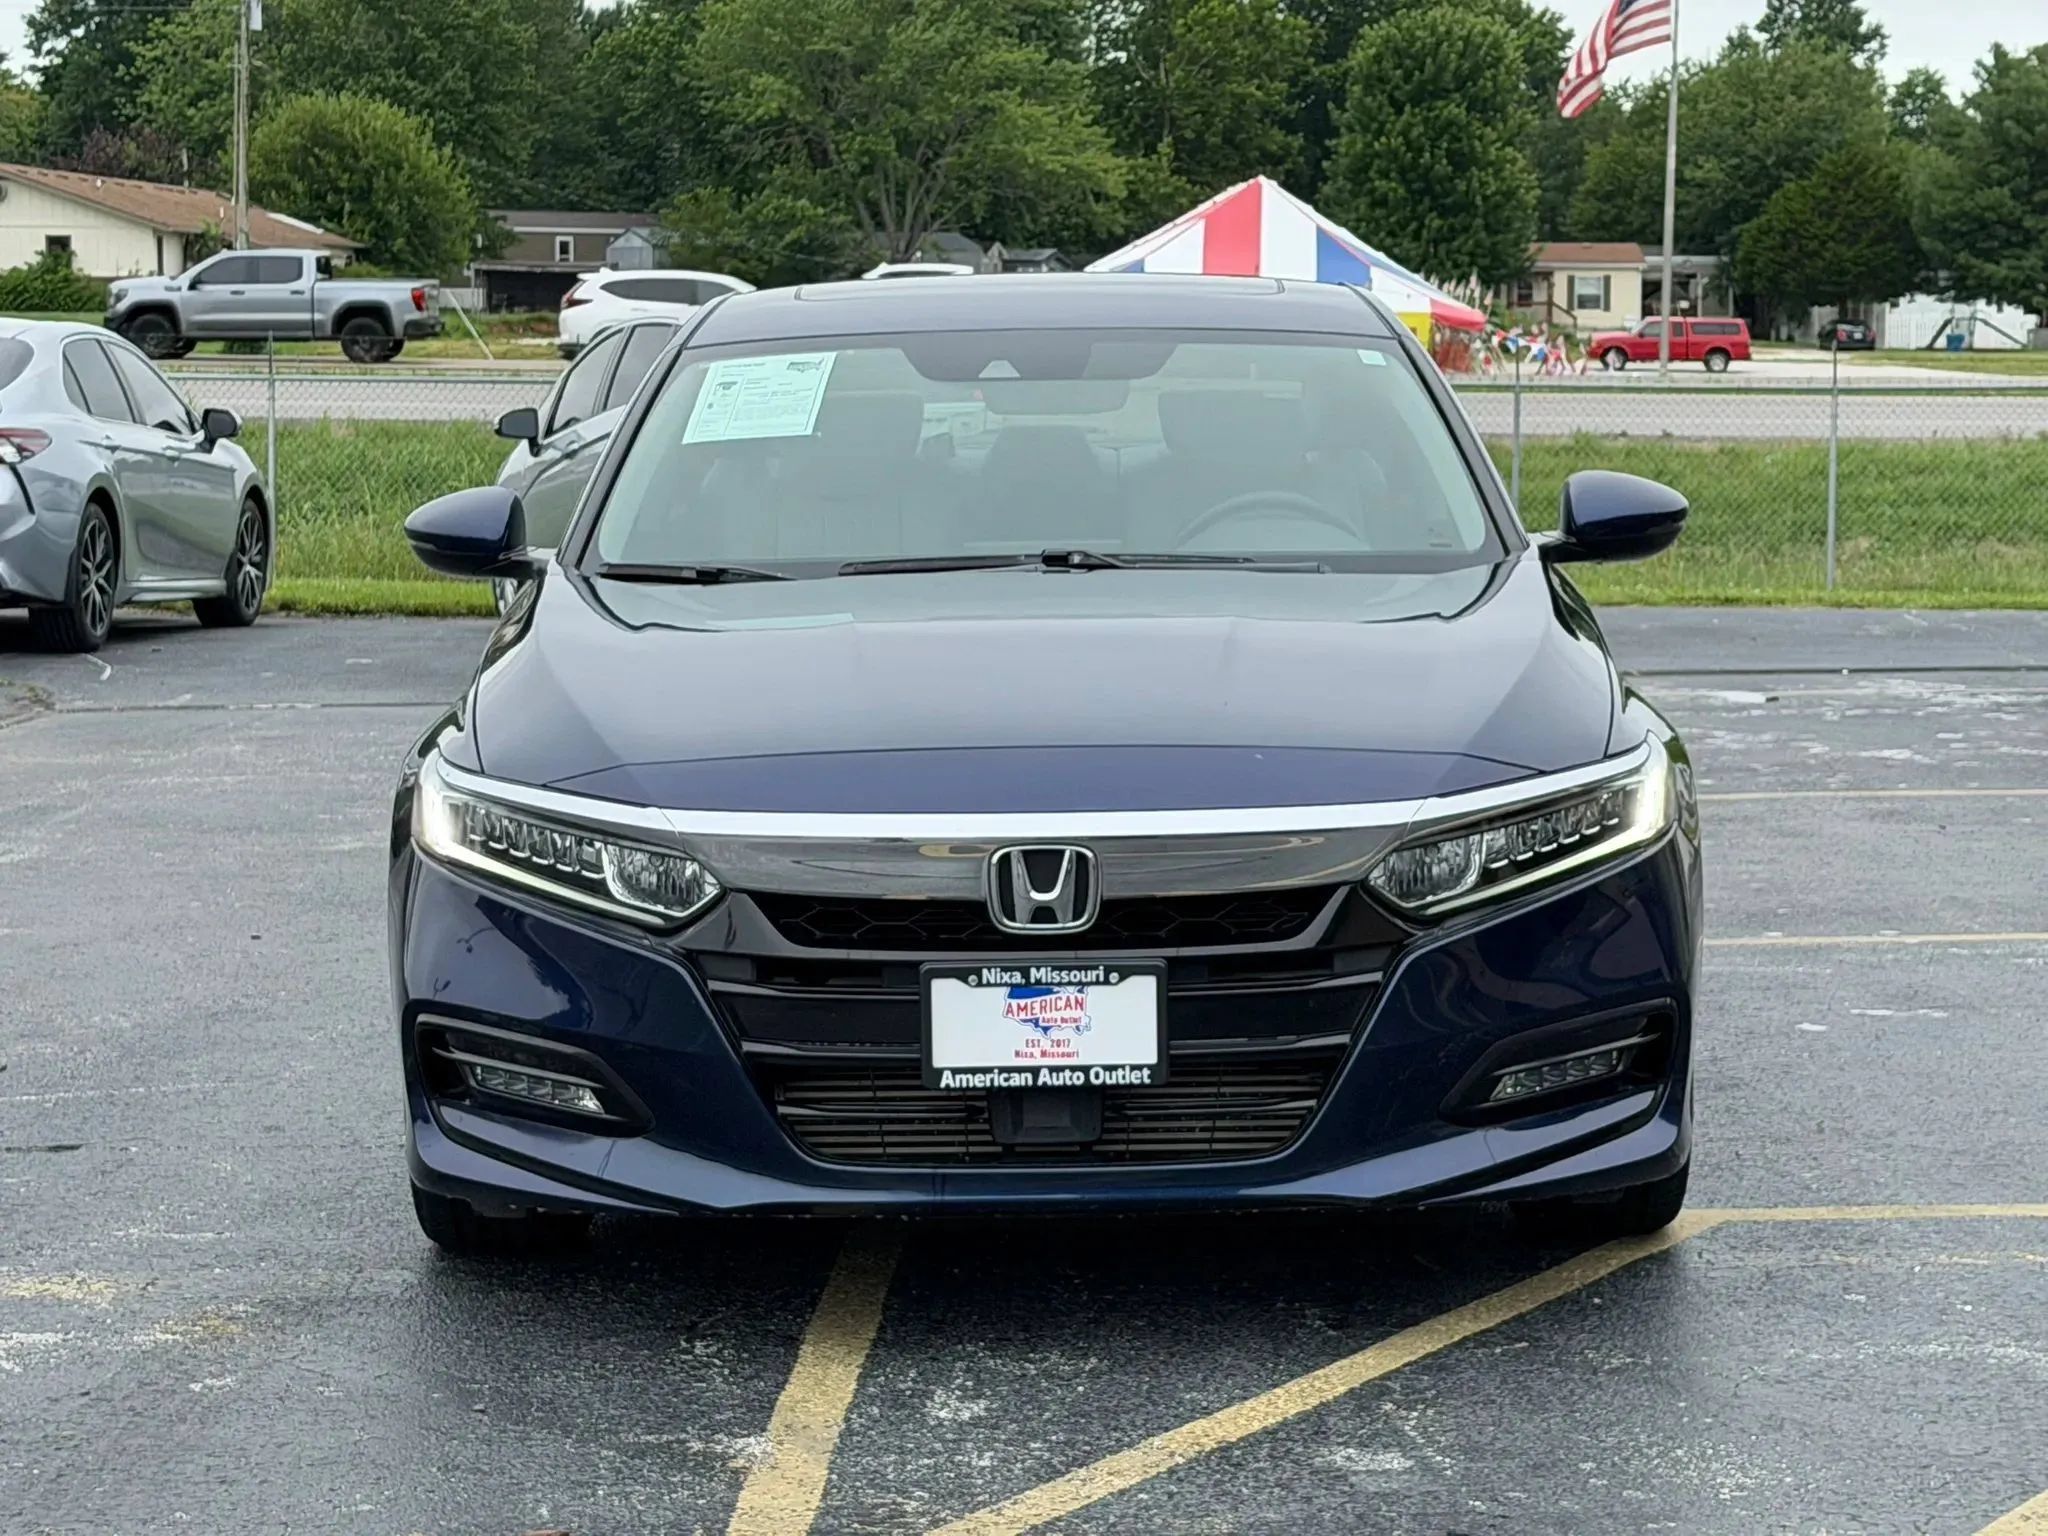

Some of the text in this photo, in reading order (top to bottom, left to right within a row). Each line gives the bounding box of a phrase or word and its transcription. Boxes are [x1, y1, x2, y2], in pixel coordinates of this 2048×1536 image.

[982, 965, 1105, 985] Nixa, Missouri
[1005, 995, 1085, 1017] AMERICAN
[1041, 1015, 1082, 1024] Auto Outlet
[1025, 1038, 1071, 1049] EST. 2017
[1040, 1049, 1080, 1059] Missouri
[940, 1064, 1151, 1089] American Auto Outlet
